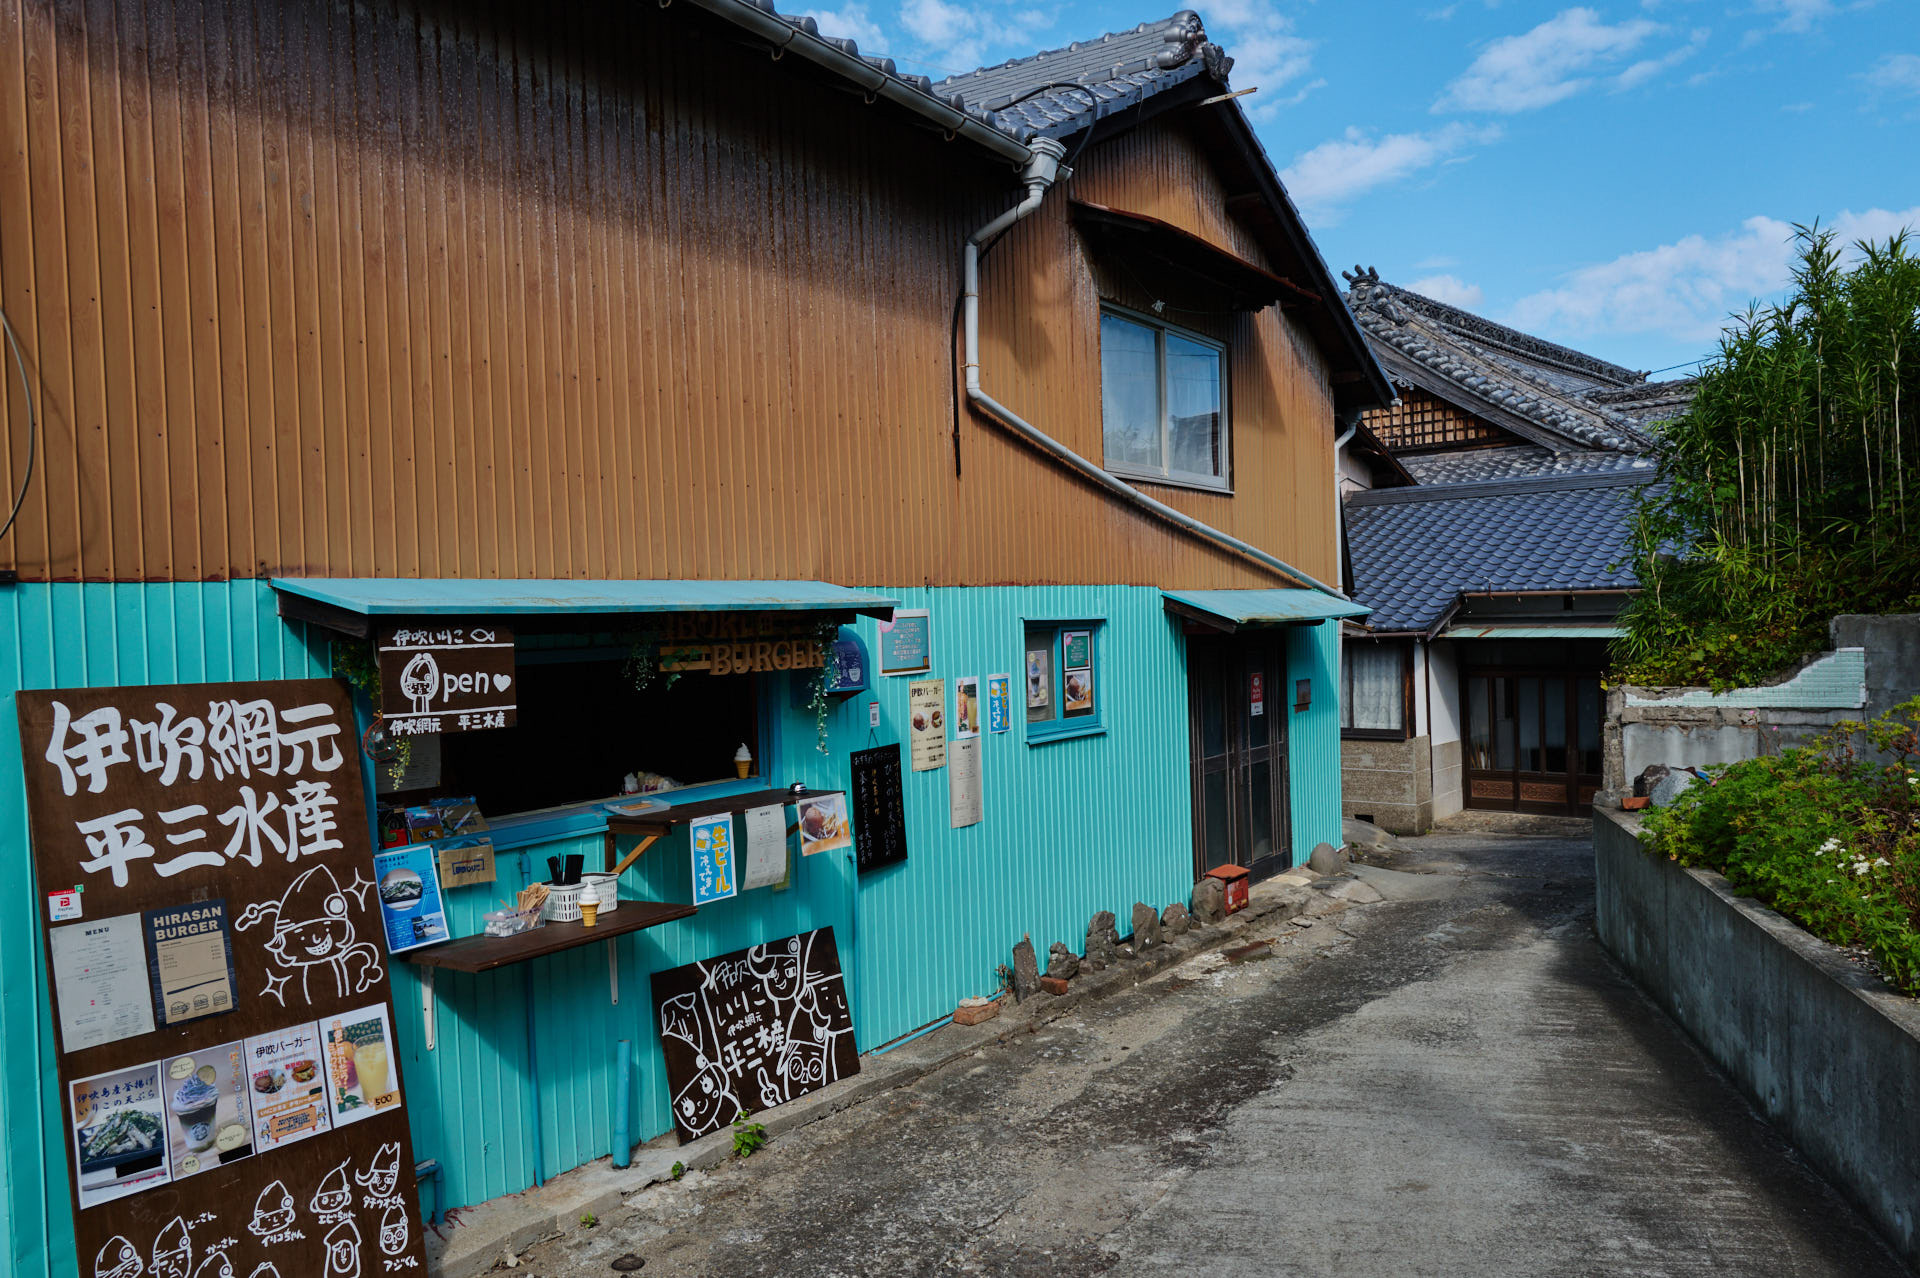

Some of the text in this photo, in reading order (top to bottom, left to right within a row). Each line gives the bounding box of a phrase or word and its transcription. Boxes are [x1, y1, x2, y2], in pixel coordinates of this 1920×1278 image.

[392, 629, 464, 646] 伊吹いりこ
[709, 640, 825, 675] BURGER
[389, 711, 506, 736] 伊吹網元 平三水産
[46, 699, 344, 797] 伊吹網元
[75, 780, 344, 889] 平三水産
[711, 825, 731, 894] 生ビール
[153, 906, 222, 928] HIRASAN
[85, 927, 110, 936] MENU
[155, 920, 218, 941] BURGER
[714, 983, 767, 1026] いりこ
[727, 1011, 763, 1036] 伊吹網元
[256, 1036, 311, 1058] 伊吹バーガー
[723, 1019, 787, 1078] 平三水産
[77, 1075, 155, 1103] 伊吹島産釜揚げ
[375, 1094, 393, 1106] 500
[79, 1089, 155, 1116] いりこの天ぷら
[363, 1192, 406, 1209] タチウオくん
[187, 1211, 217, 1230] とーさん
[318, 1209, 356, 1224] エビちゃん
[205, 1236, 239, 1254] かーさん
[261, 1227, 306, 1247] イリコちゃん
[383, 1255, 419, 1272] アジくん
